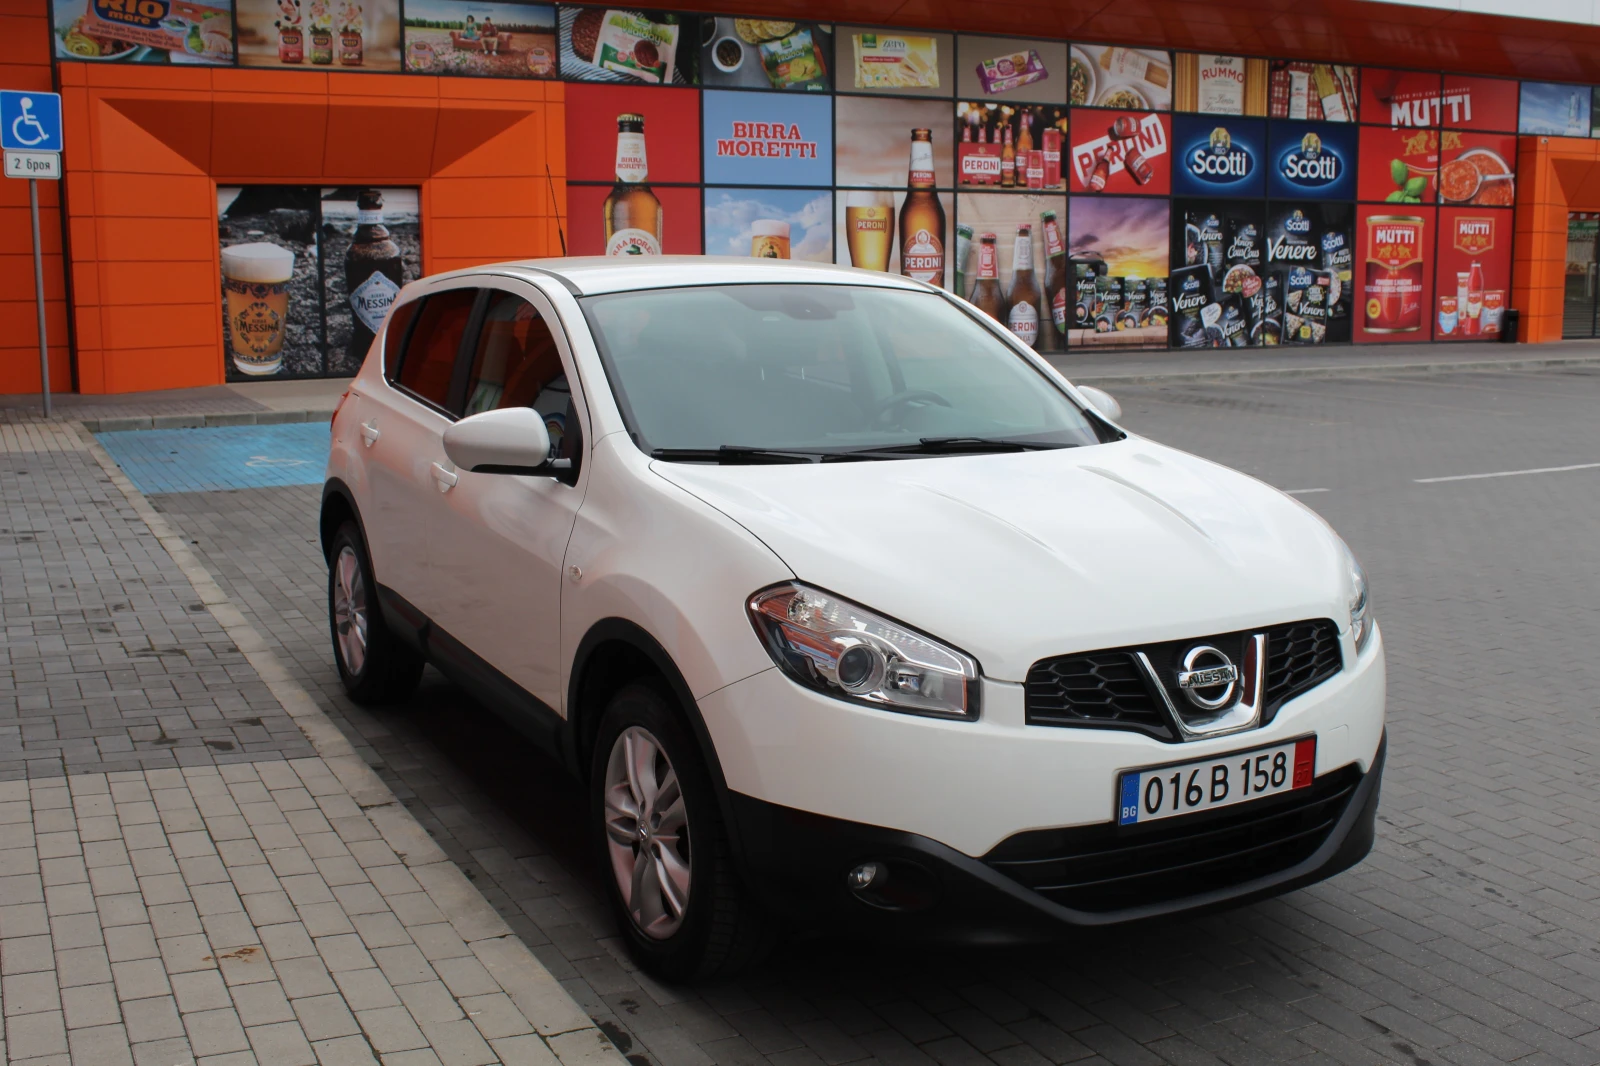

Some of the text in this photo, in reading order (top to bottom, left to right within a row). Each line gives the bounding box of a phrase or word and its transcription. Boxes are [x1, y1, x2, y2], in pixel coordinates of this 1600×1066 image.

[108, 11, 150, 25] mare
[1202, 67, 1244, 84] RUMMO
[1391, 94, 1472, 131] MUTTI
[733, 122, 802, 140] BIRRA
[717, 139, 818, 158] MORETTI
[14, 158, 50, 172] 2 броя
[964, 160, 1000, 170] PERONI
[1193, 150, 1246, 176] Scotti
[1286, 154, 1336, 179] Scotti
[857, 221, 885, 229] PERONI
[1286, 220, 1310, 232] Scotti
[1460, 224, 1490, 235] MUTTI
[1376, 230, 1415, 244] MUTTI
[1267, 234, 1317, 262] Venere
[905, 256, 942, 268] PERONI
[1078, 280, 1096, 290] Vener
[1172, 293, 1207, 312] Venere
[1220, 320, 1246, 339] Venere
[1188, 668, 1236, 687] NISSAN
[1144, 752, 1286, 814] 016 B 158
[1122, 805, 1136, 818] BG
